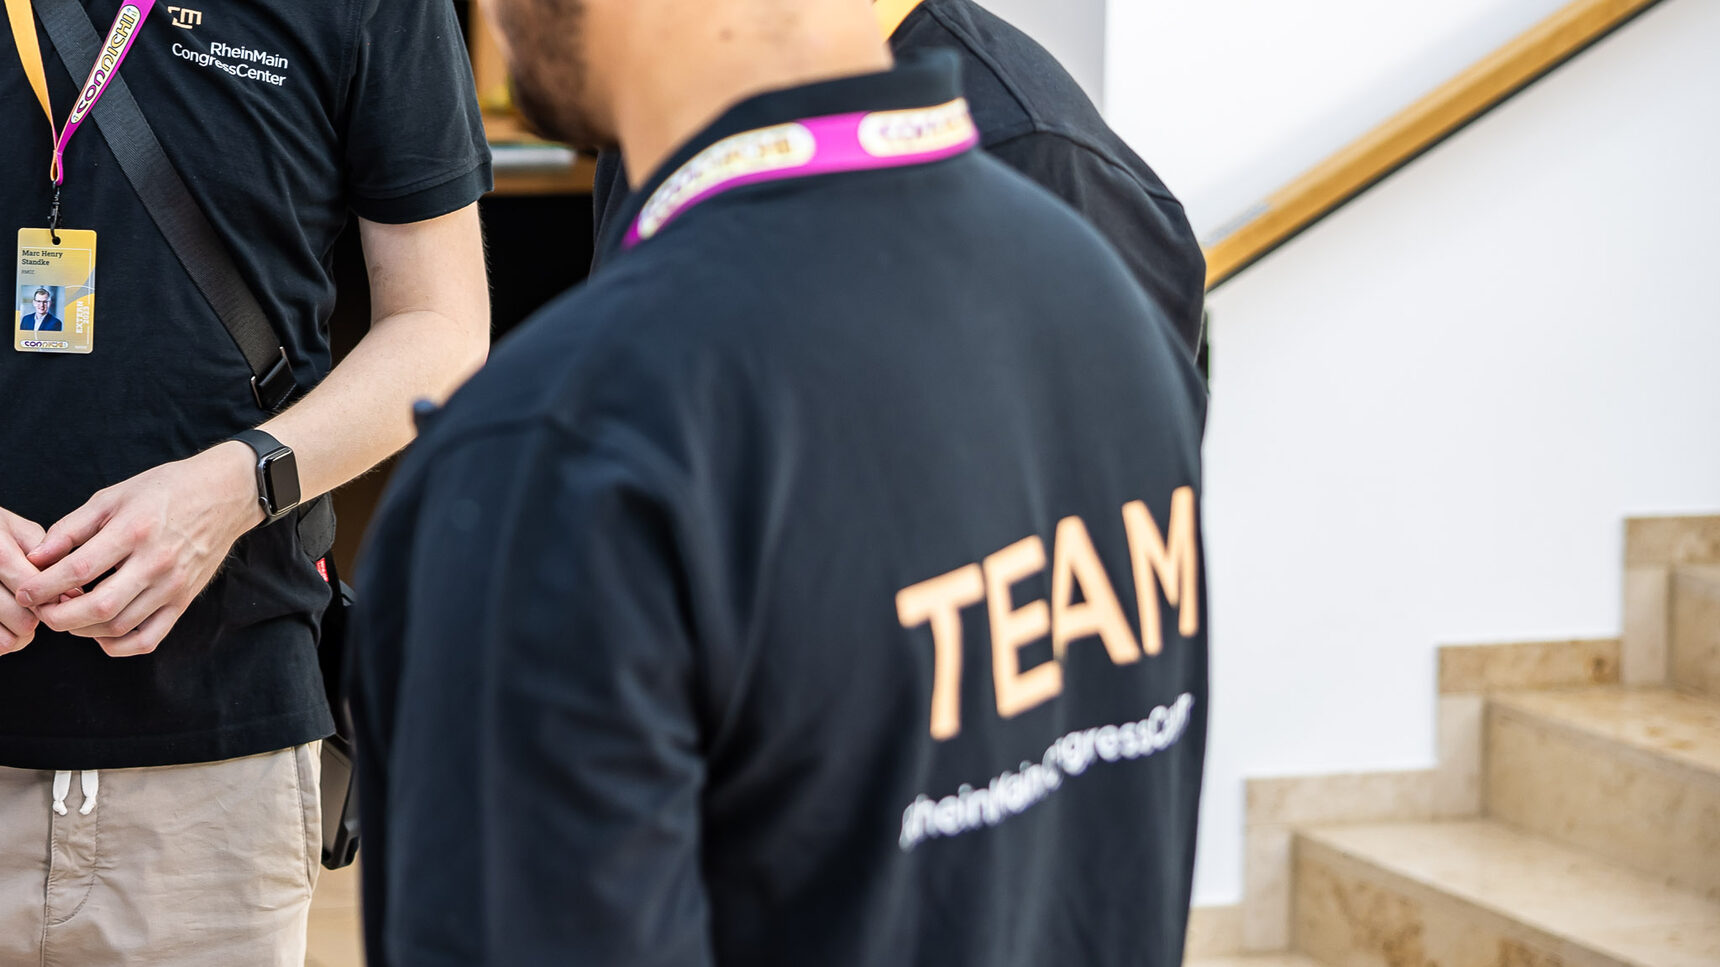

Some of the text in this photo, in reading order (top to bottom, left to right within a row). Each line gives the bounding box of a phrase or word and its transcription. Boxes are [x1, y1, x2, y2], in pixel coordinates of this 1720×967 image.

[76, 12, 135, 115] CONNICHI
[172, 42, 287, 86] CongressCenter
[210, 41, 288, 69] RheinMain
[21, 249, 63, 259] Marc Henry
[21, 258, 50, 266] Standke
[895, 485, 1199, 741] TEAM
